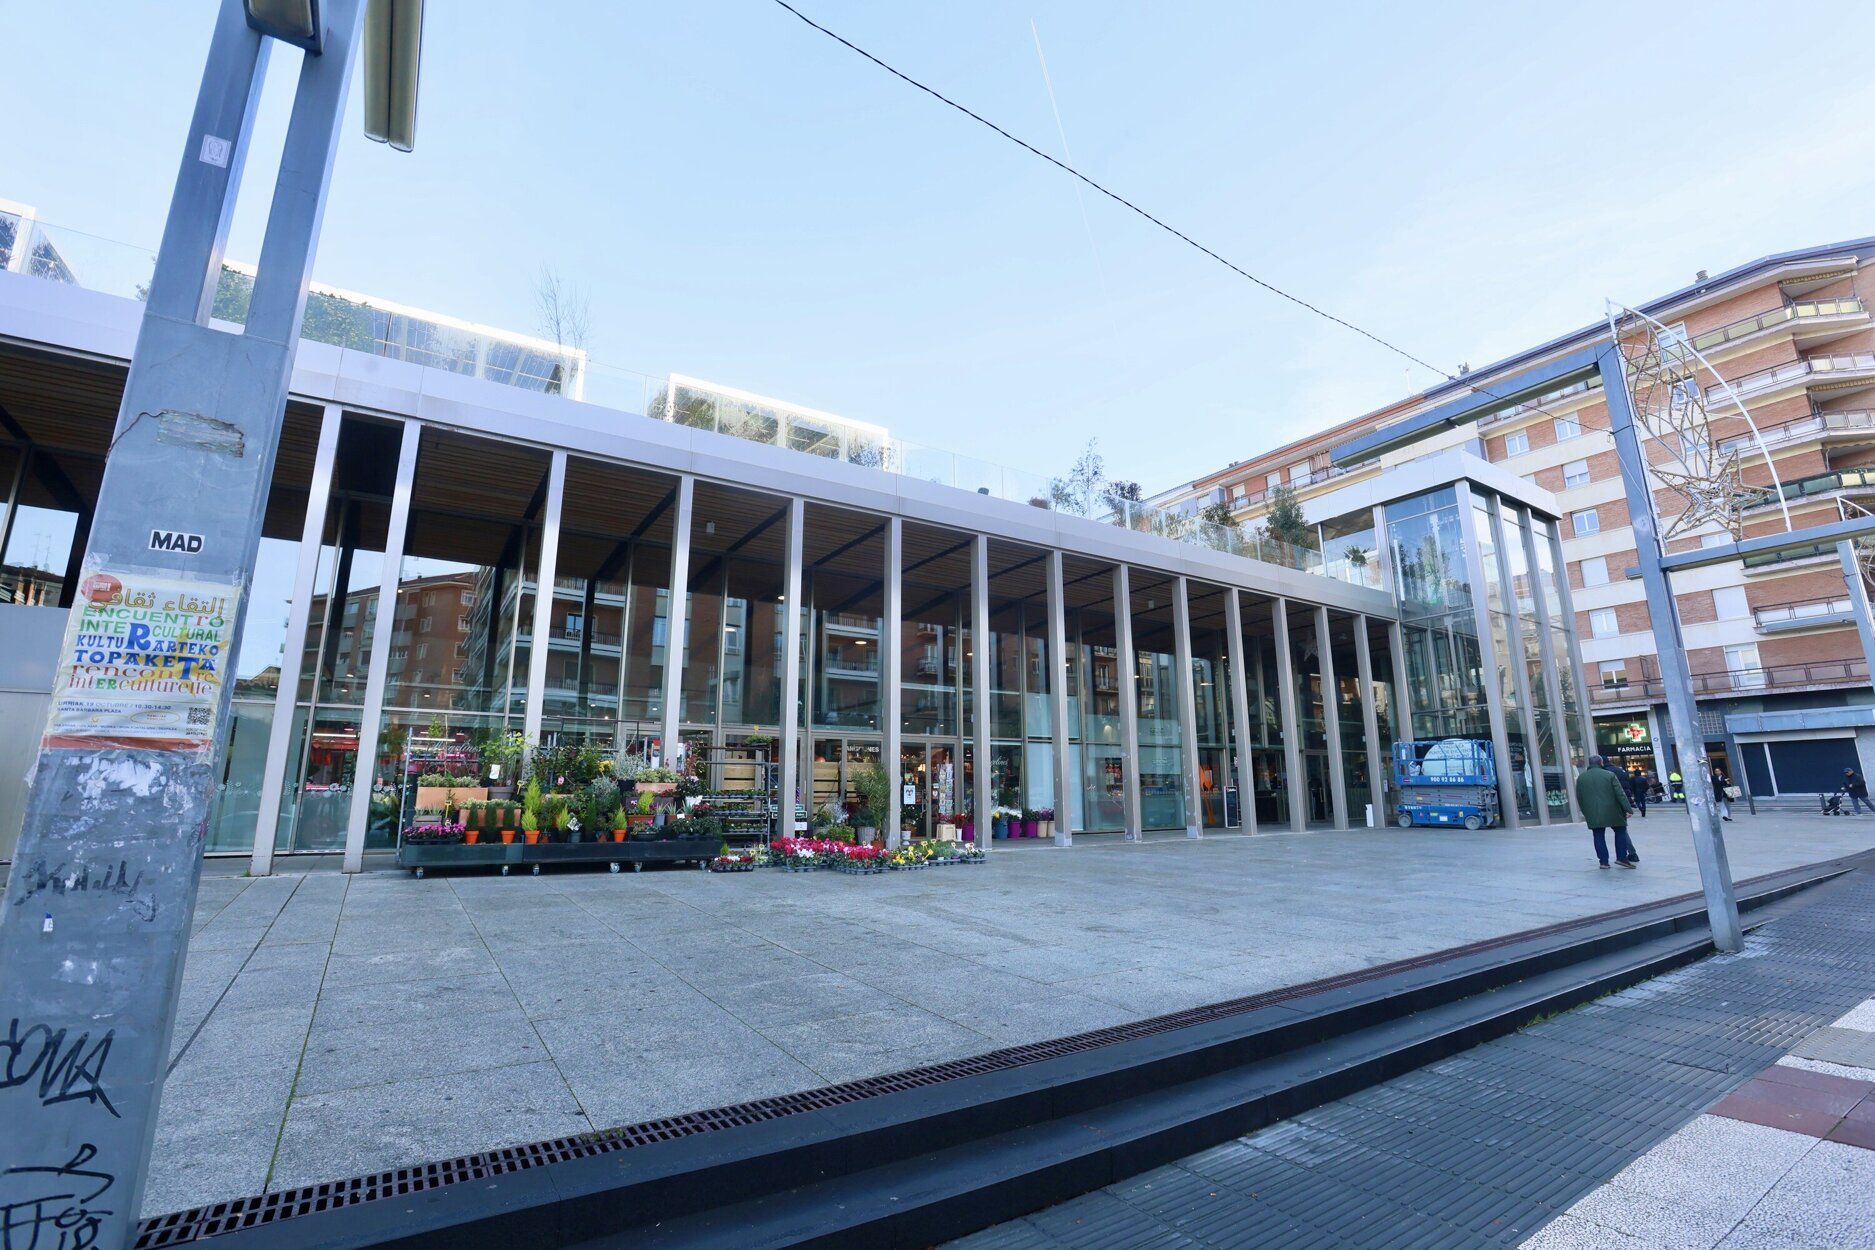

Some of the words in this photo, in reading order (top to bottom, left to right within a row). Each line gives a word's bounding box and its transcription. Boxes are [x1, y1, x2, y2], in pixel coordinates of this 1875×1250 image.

[151, 531, 202, 553] MAD
[74, 650, 216, 680] TOPAKETA
[1617, 745, 1651, 753] FARMACIA
